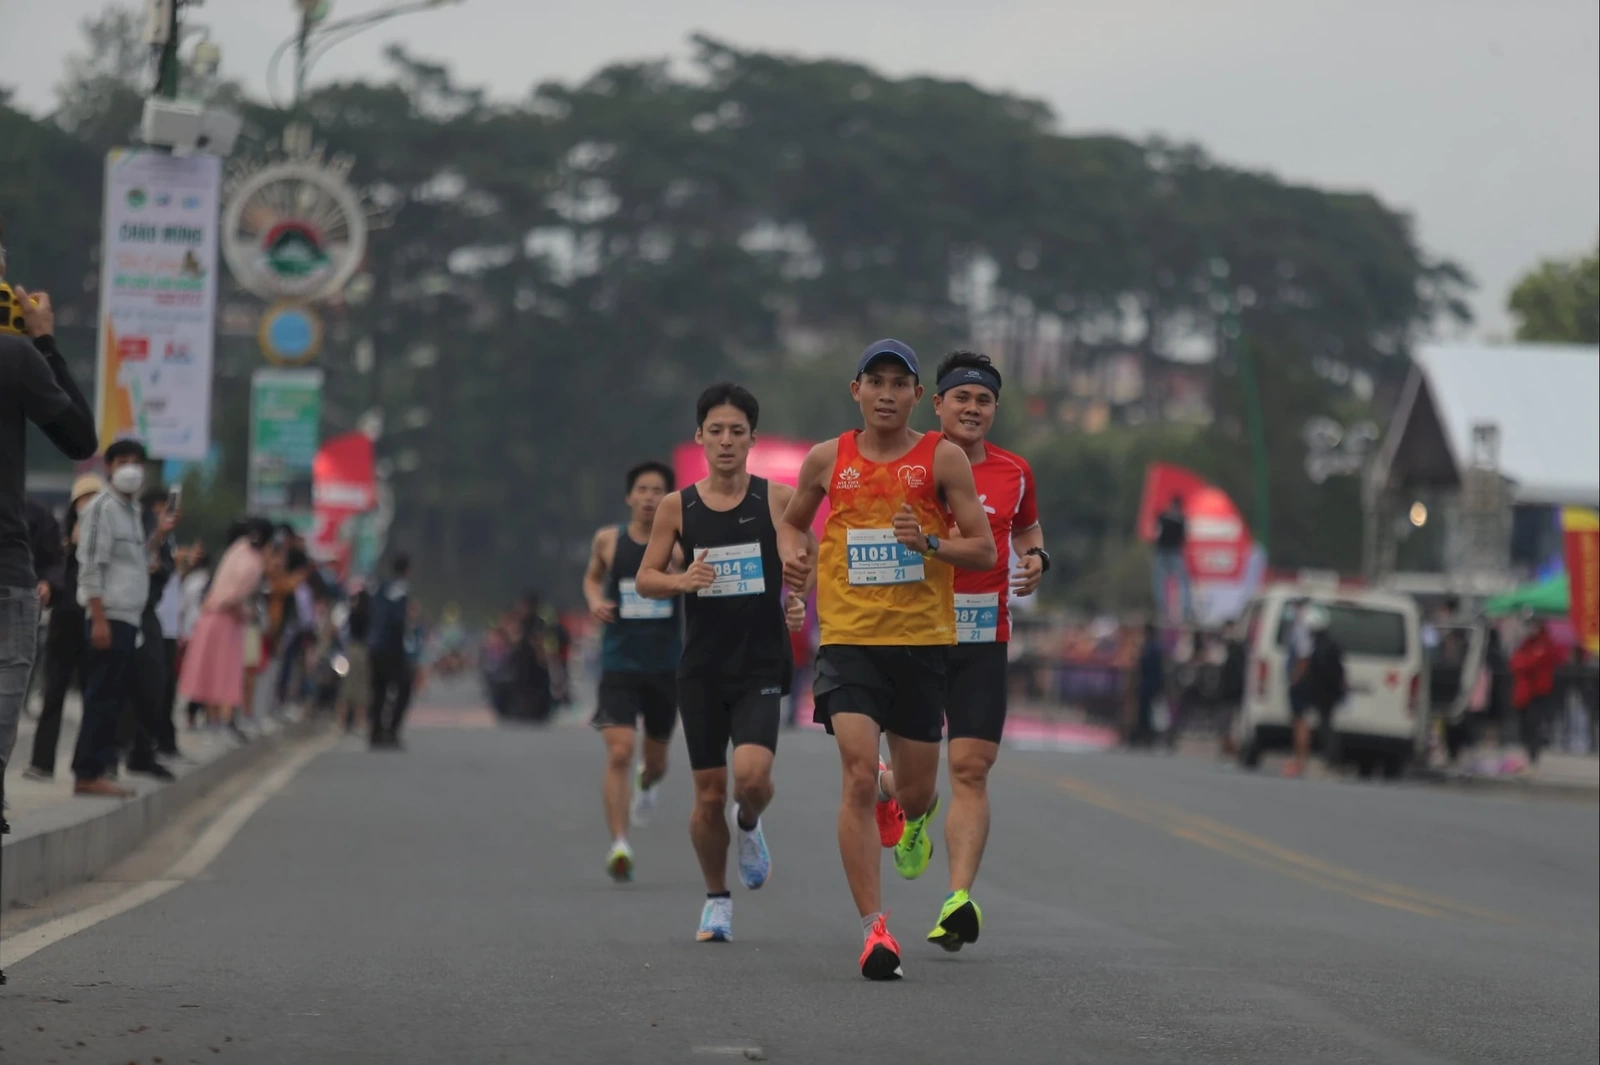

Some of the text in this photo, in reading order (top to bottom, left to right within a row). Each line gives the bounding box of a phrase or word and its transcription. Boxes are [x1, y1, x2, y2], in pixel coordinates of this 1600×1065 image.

[850, 546, 897, 561] 21051
[894, 568, 906, 580] 21
[737, 581, 748, 593] 21
[970, 630, 981, 640] 21
